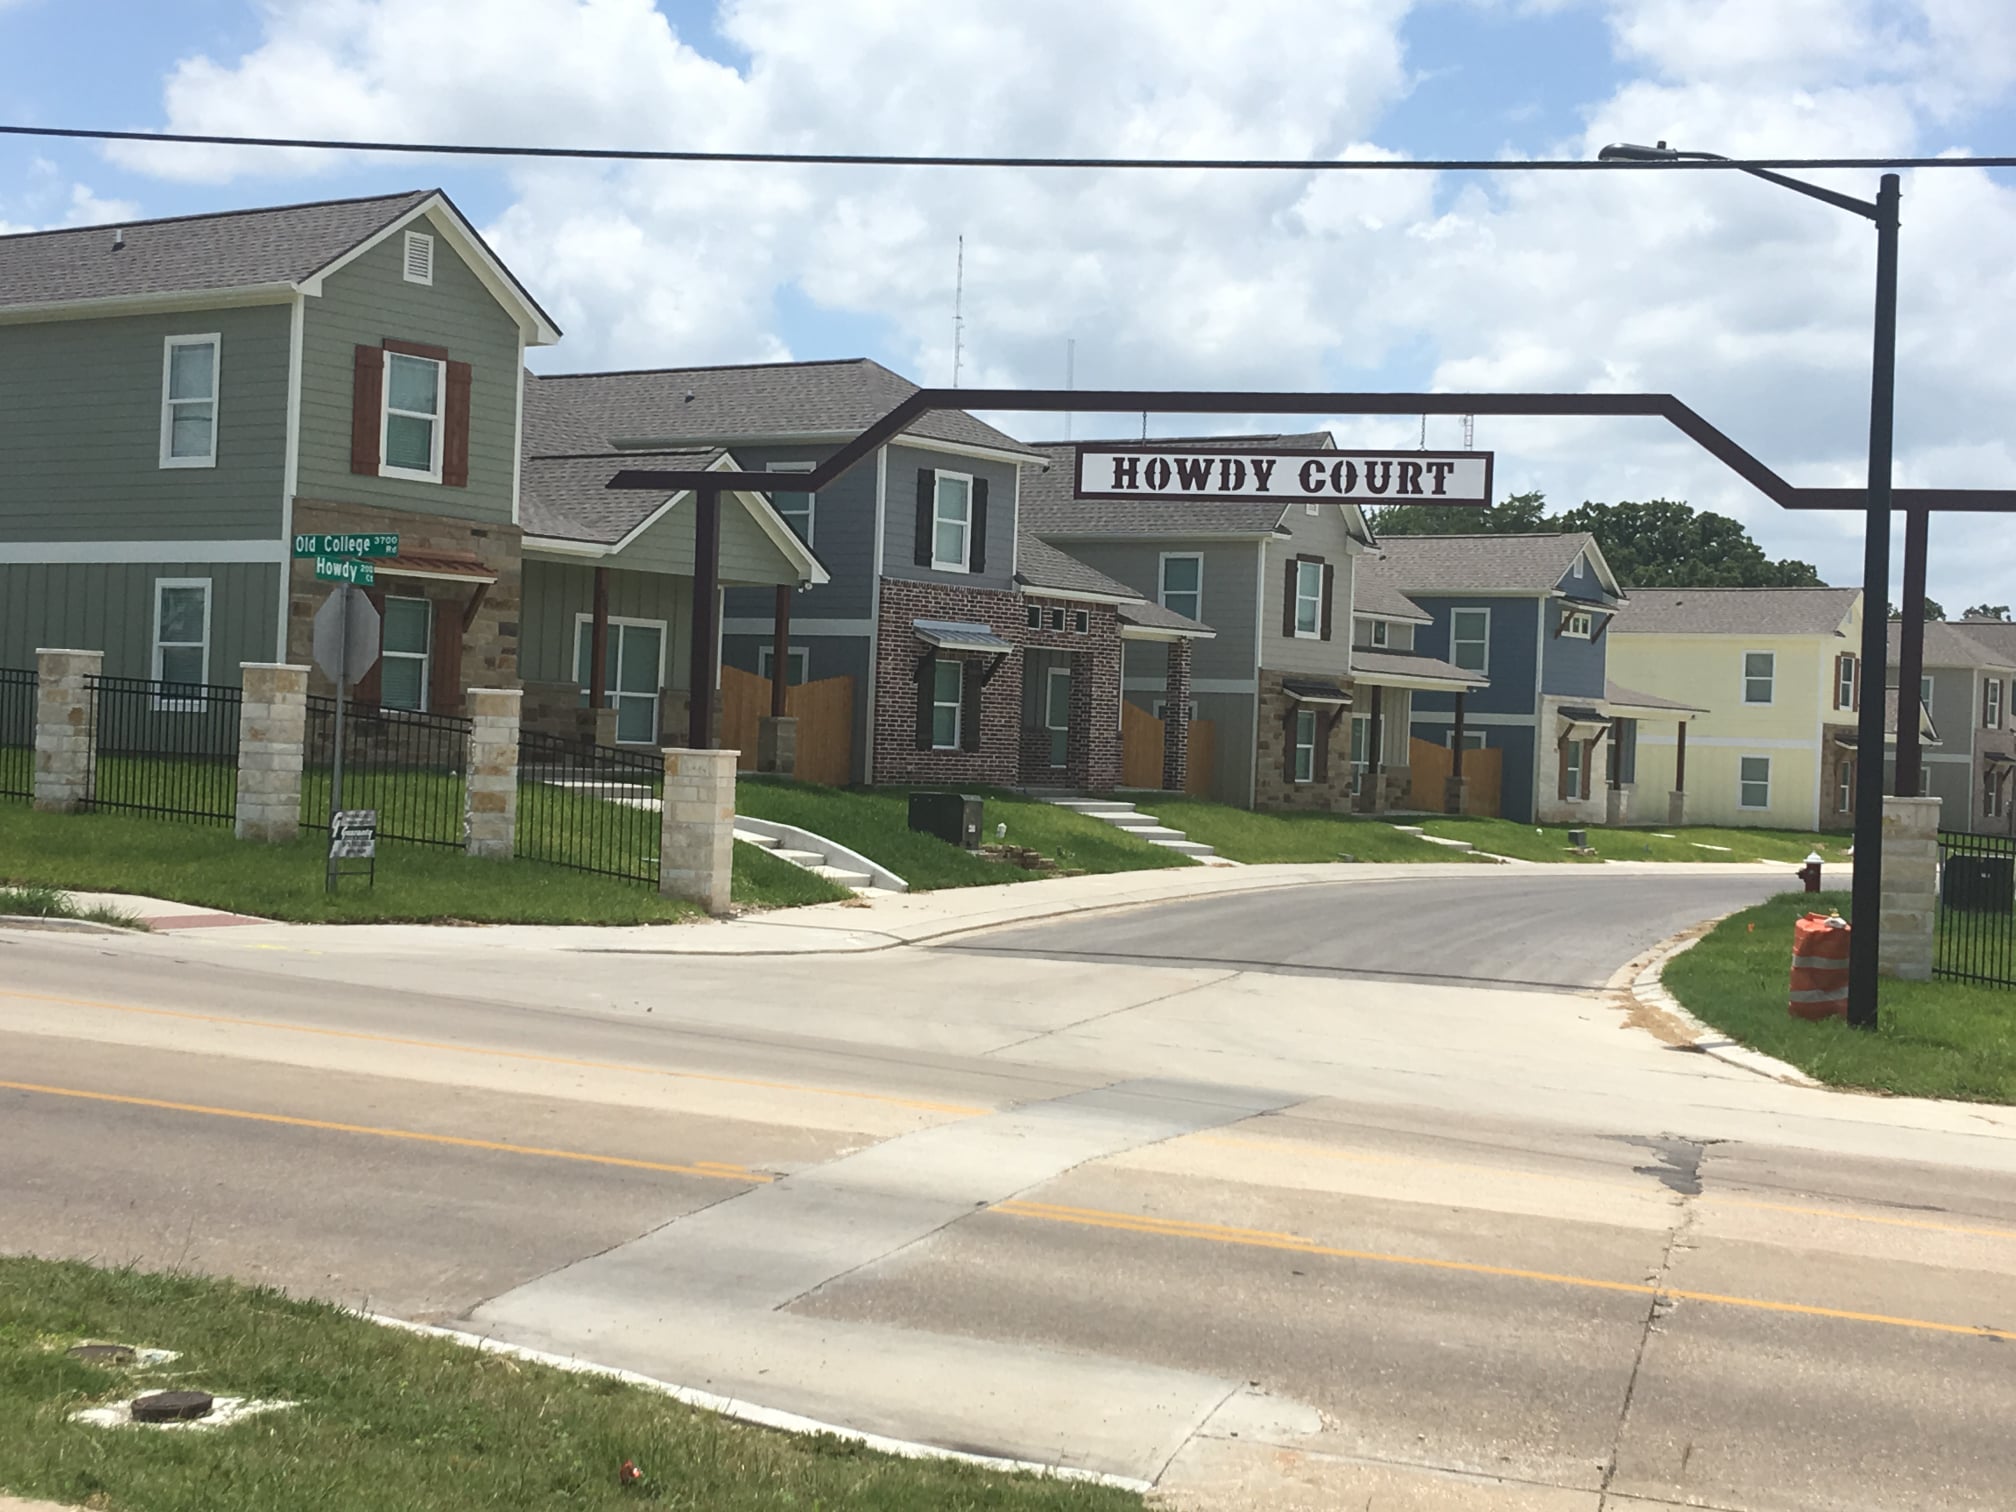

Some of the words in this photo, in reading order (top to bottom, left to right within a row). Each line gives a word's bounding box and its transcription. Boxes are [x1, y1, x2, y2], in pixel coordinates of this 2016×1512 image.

[1111, 457, 1276, 492] HOWDY
[1299, 459, 1455, 496] COURT
[295, 535, 316, 553] Old
[324, 535, 371, 557] College
[374, 536, 398, 545] 3700
[385, 545, 398, 554] Rd
[316, 556, 358, 583] Howdy
[365, 574, 374, 583] Ct
